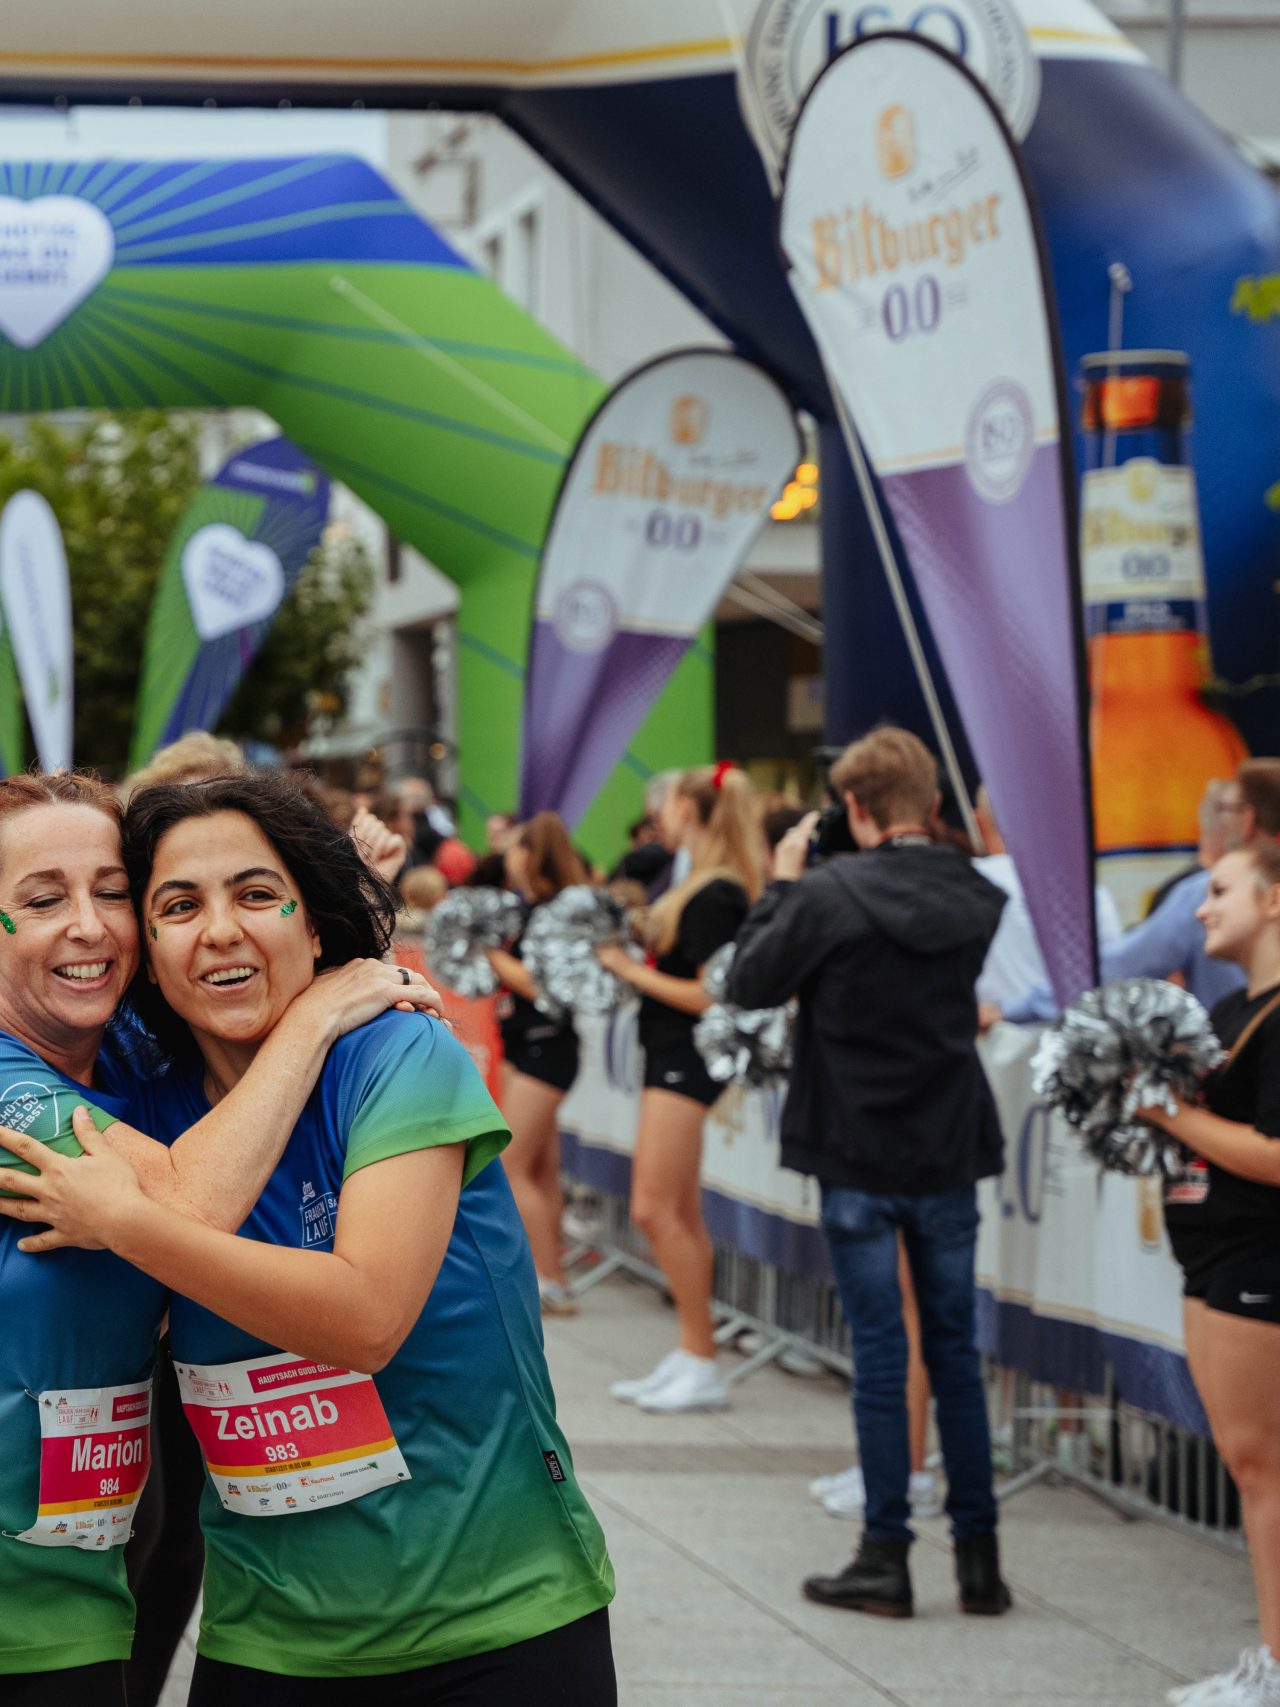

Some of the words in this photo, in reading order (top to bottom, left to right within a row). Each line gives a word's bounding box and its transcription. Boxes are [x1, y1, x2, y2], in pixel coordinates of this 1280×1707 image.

[811, 193, 1002, 291] Bitburger
[593, 442, 767, 520] Bitburger
[16, 1103, 48, 1133] IEBST.
[306, 1216, 329, 1242] LAUF
[257, 1368, 298, 1385] HAUPTSACH
[210, 1394, 339, 1441] Zeinab
[71, 1434, 142, 1472] Marion
[265, 1443, 299, 1462] 983
[100, 1477, 119, 1495] 984
[55, 1521, 68, 1530] dm
